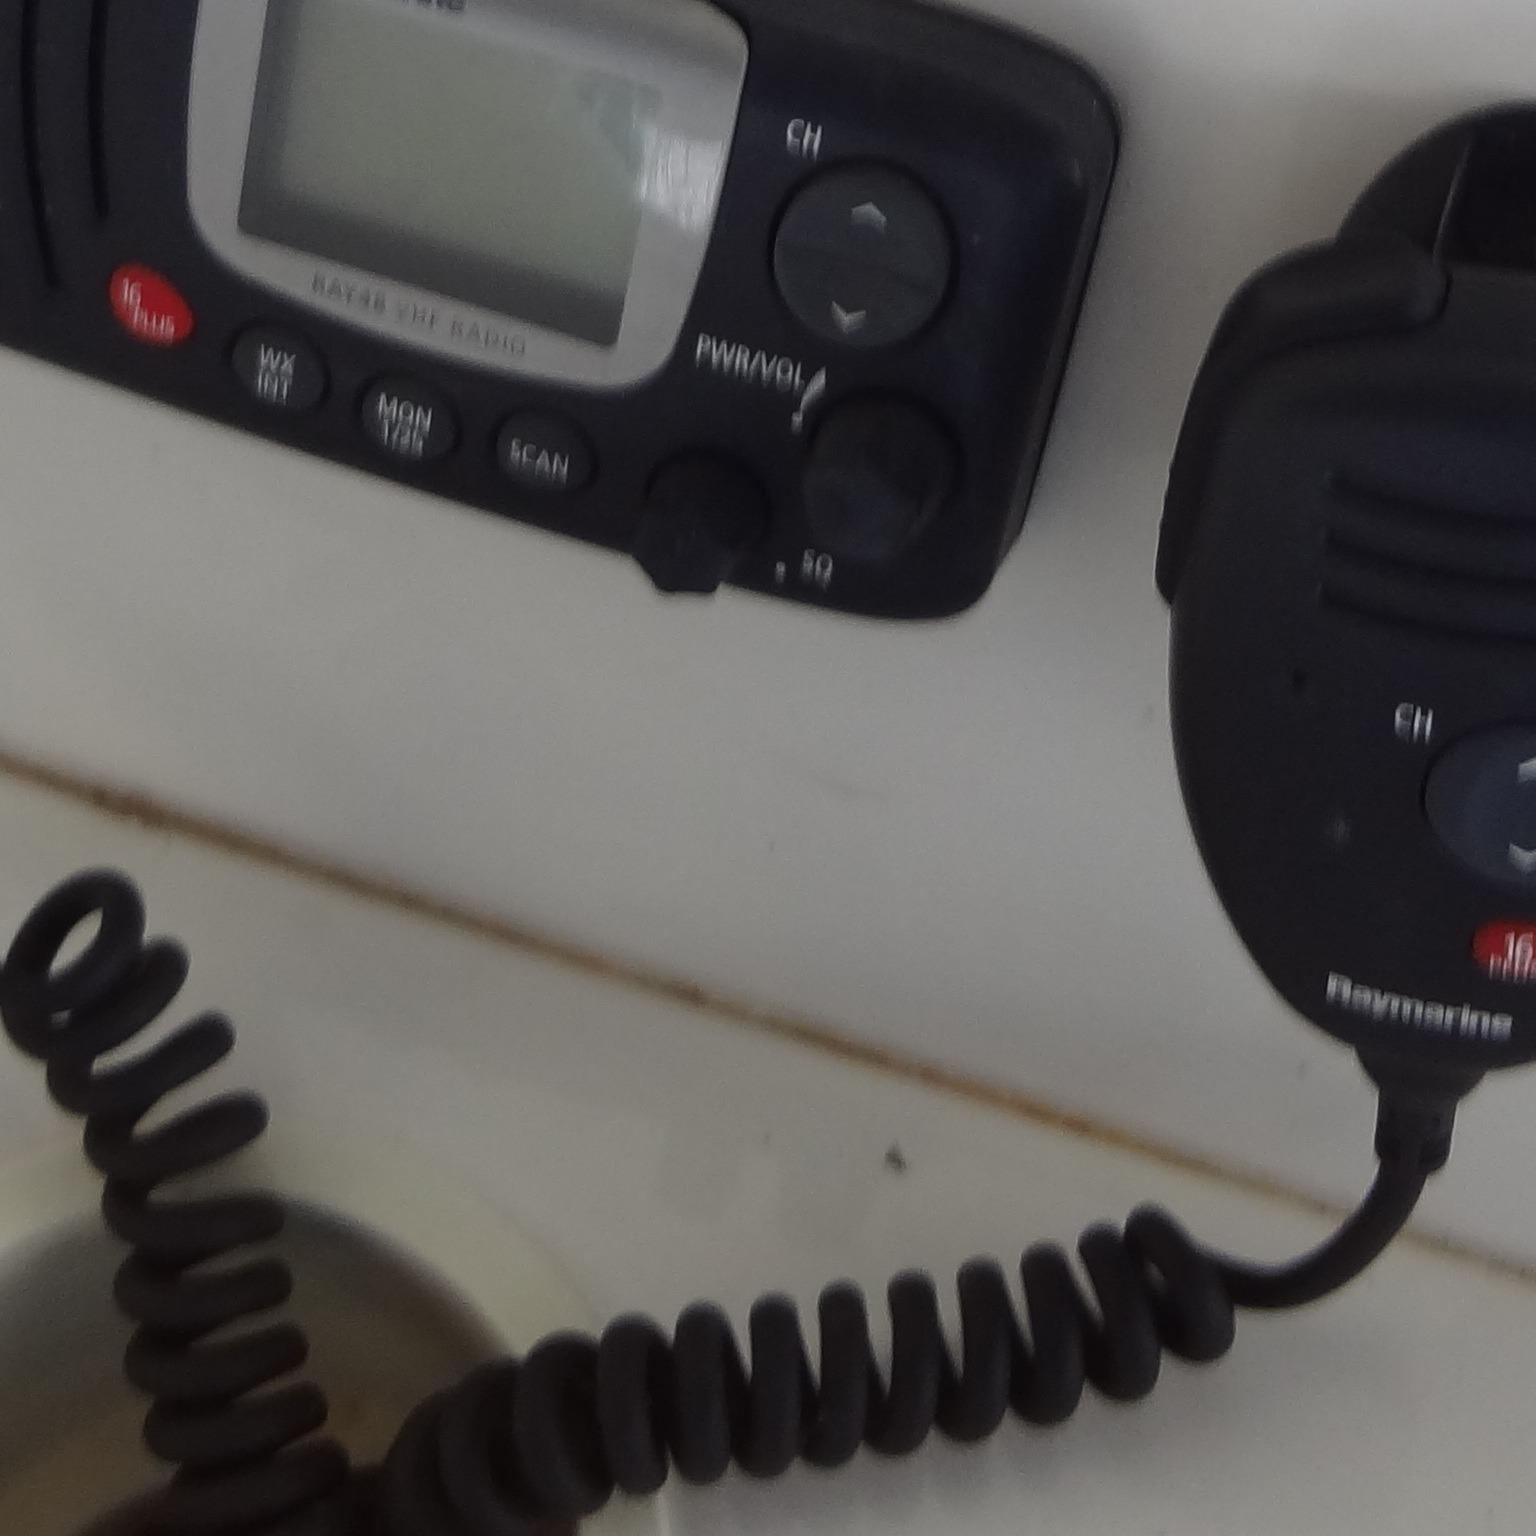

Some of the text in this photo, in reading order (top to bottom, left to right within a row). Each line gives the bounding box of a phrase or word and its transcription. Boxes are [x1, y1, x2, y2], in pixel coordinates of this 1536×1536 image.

[786, 117, 823, 161] CH
[260, 343, 296, 375] WX
[449, 318, 526, 358] RADIO
[695, 332, 806, 393] PWR/VOL
[378, 390, 433, 433] MON
[509, 435, 570, 479] SCAN
[1394, 702, 1434, 745] CH
[1503, 930, 1535, 968] 16
[1325, 970, 1514, 1043] Raymarine
